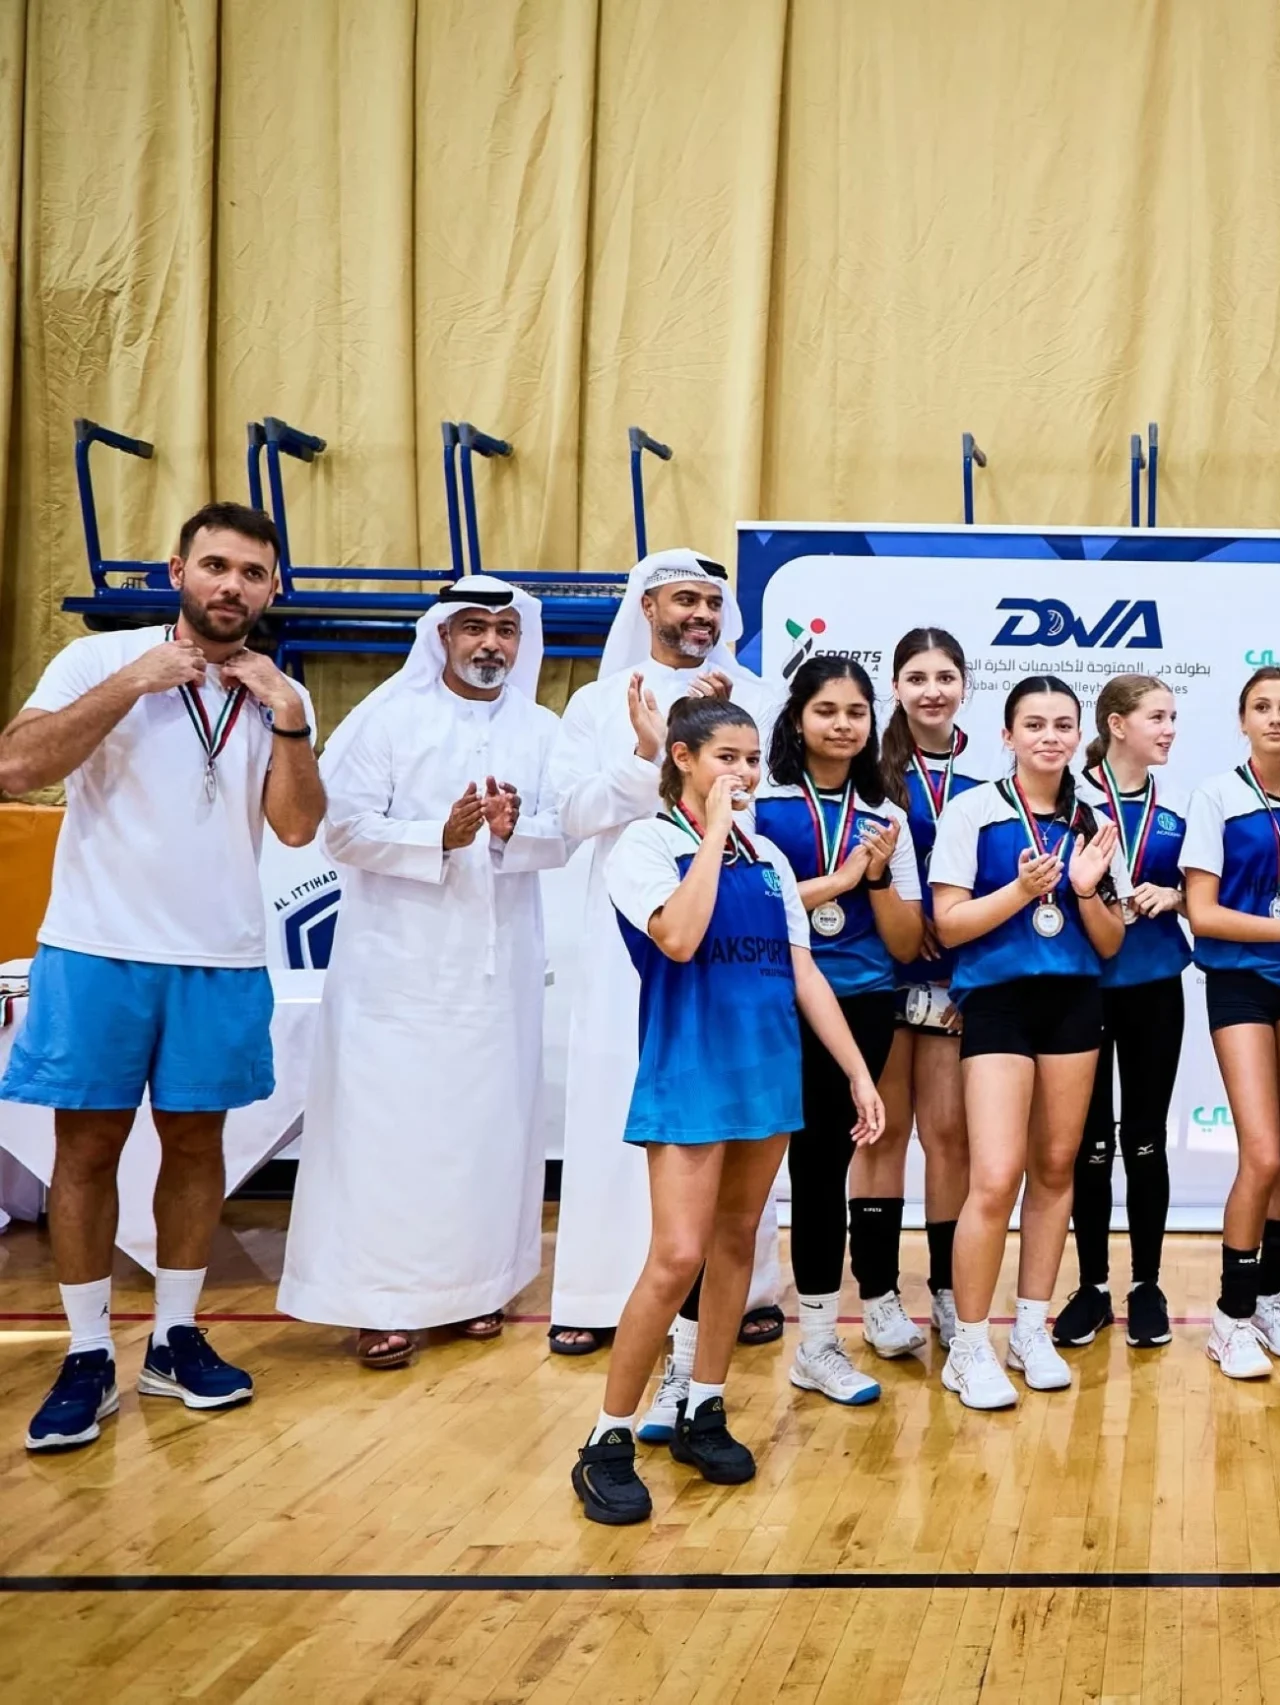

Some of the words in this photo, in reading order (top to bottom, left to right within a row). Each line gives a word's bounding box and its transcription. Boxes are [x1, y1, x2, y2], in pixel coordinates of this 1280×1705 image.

[984, 658, 1015, 674] الكرة
[1174, 662, 1210, 678] بطولة
[274, 898, 290, 912] AL
[291, 870, 338, 900] ITTIHAD
